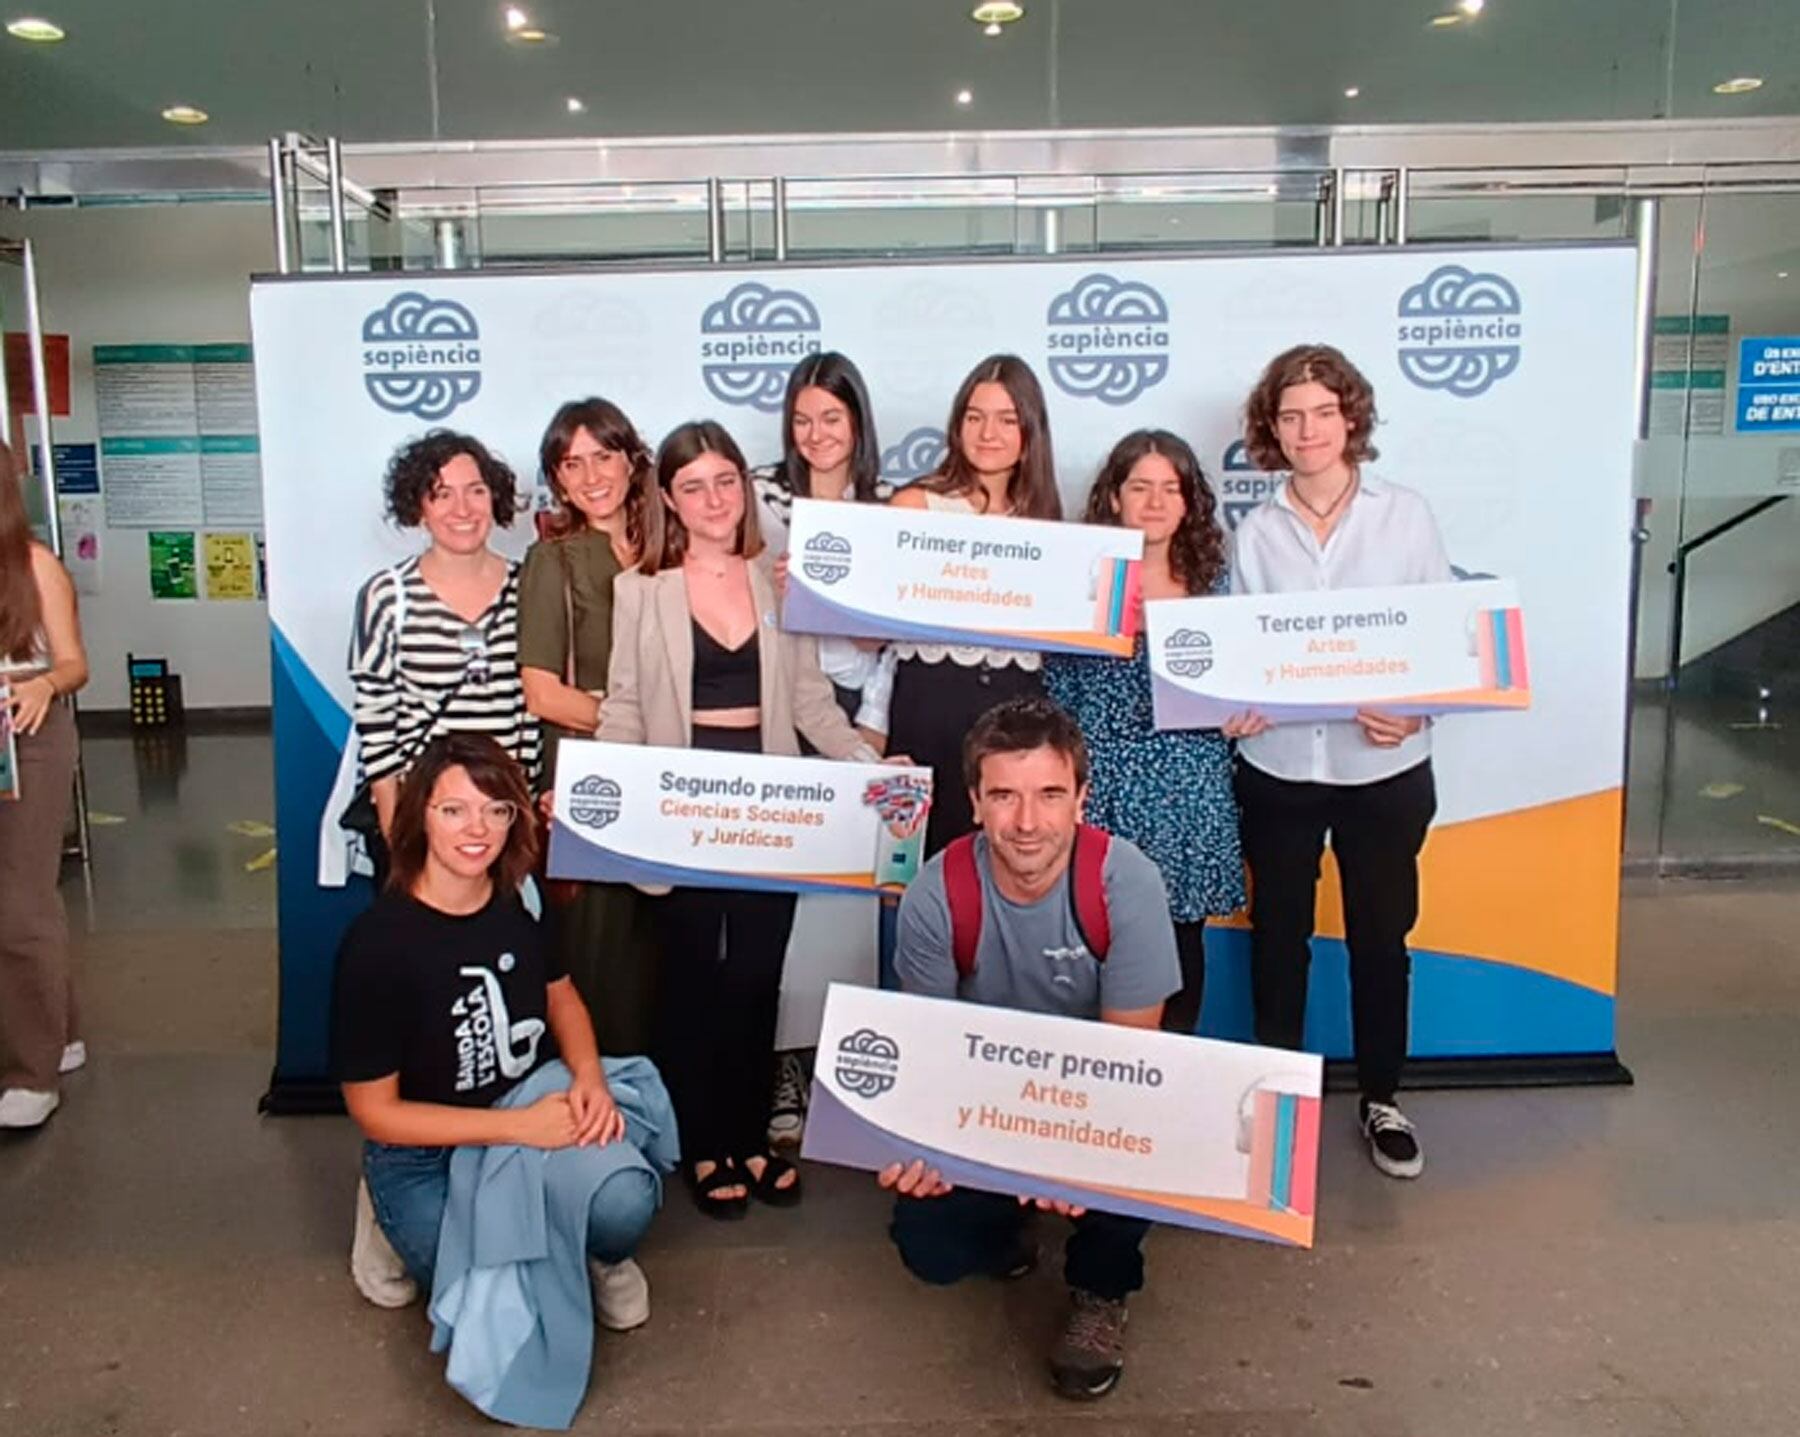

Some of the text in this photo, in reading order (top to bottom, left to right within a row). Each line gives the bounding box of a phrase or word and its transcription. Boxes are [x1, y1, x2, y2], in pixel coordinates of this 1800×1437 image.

[1047, 325, 1169, 353] sapiència
[1398, 317, 1521, 346] sapiència
[363, 342, 480, 370] sapiència
[701, 334, 821, 361] sapiència
[897, 530, 1042, 561] Primer premio
[941, 562, 991, 581] Artes
[897, 582, 1034, 608] y Humanidades
[1256, 606, 1408, 634] Tercer premio
[1307, 638, 1358, 654] Artes
[1264, 657, 1411, 685] y Humanidades
[659, 771, 836, 802] Segundo premio
[660, 798, 825, 826] Ciencias Sociales
[691, 827, 794, 849] y Jurídicas
[451, 996, 476, 1092] BANDA A
[467, 985, 497, 1089] L'ESCOLA
[964, 1033, 1163, 1088] Tercer premio
[1019, 1079, 1089, 1109] Artes
[957, 1104, 1154, 1155] y Humanidades
